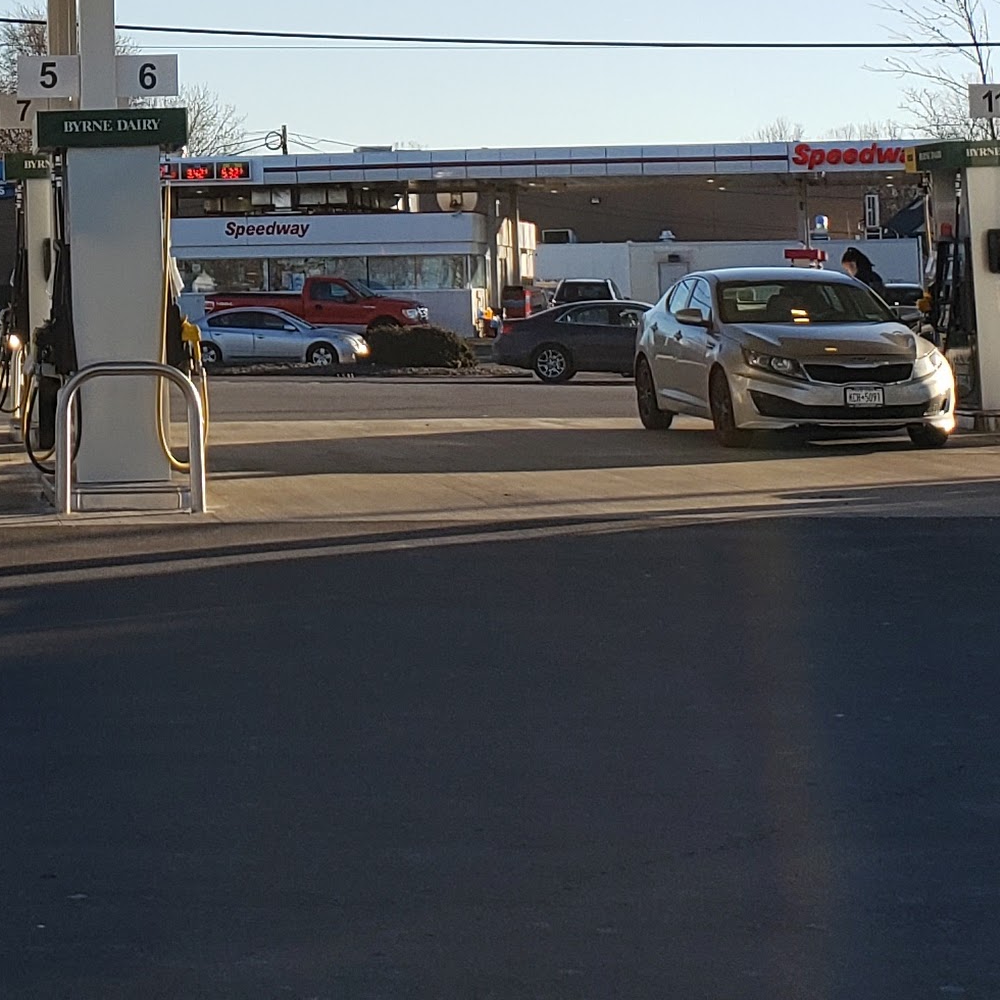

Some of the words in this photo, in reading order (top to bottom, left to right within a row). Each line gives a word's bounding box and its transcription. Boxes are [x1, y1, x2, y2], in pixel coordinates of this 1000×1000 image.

[40, 62, 57, 89] 5
[139, 63, 157, 90] 6
[17, 100, 31, 121] 7
[64, 120, 113, 133] BYRNE
[117, 118, 161, 131] DAIRY
[225, 221, 310, 239] Speedway
